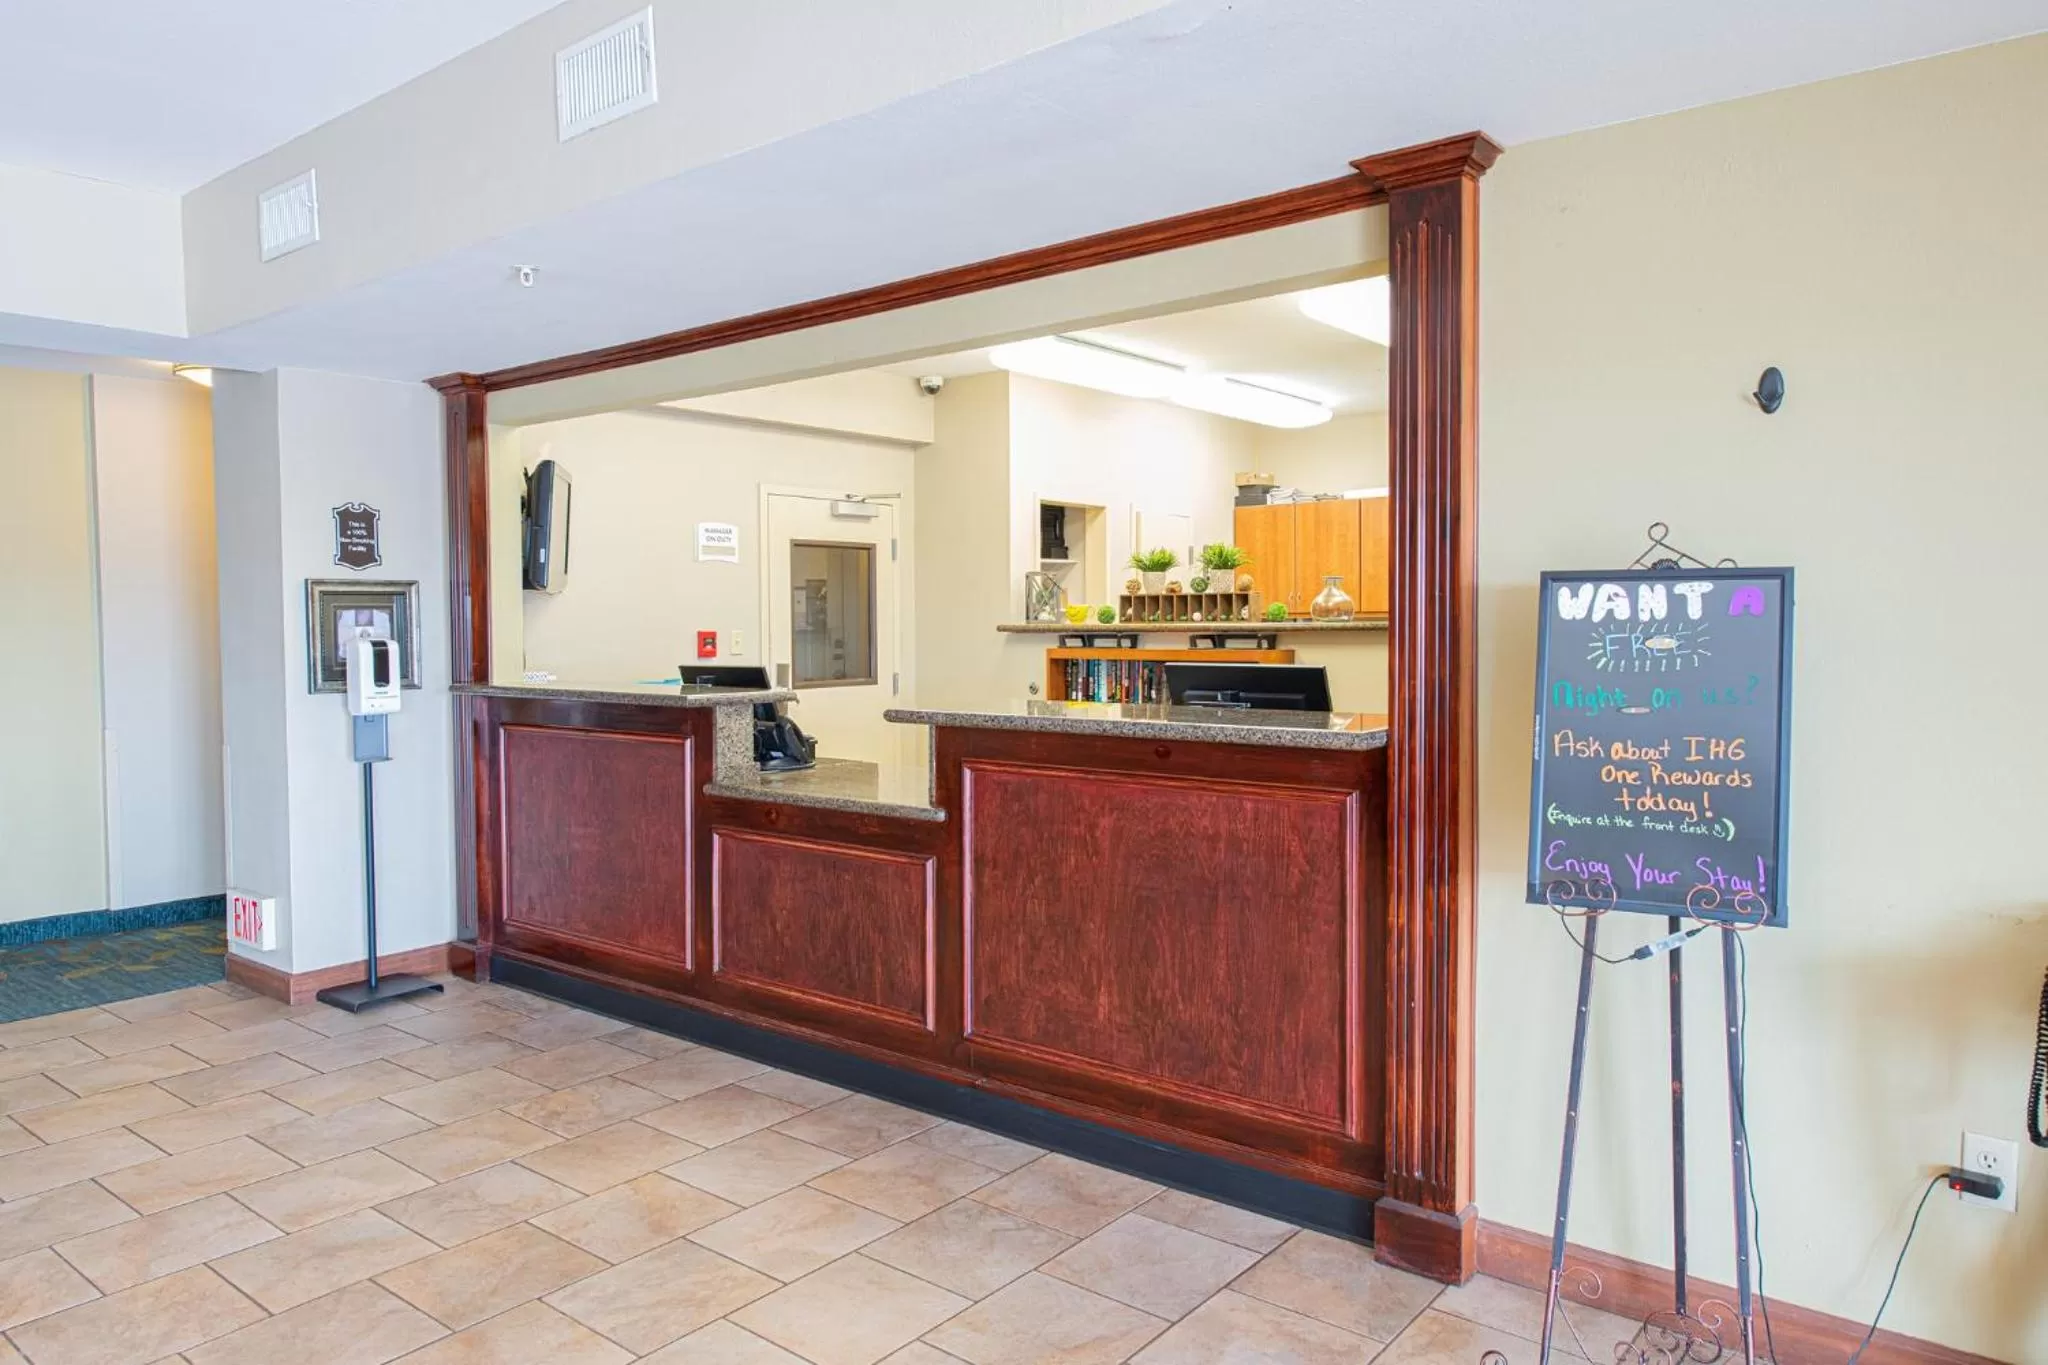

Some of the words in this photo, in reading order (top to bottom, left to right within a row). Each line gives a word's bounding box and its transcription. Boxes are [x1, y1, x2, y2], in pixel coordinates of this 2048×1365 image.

[1558, 582, 1714, 623] WANT
[1728, 585, 1765, 617] A
[1552, 679, 1627, 716] Night
[1553, 729, 1605, 758] Ask
[1610, 738, 1671, 761] about
[1683, 736, 1747, 761] IHG
[1600, 765, 1641, 785] One
[1648, 761, 1753, 787] Rewards
[1597, 813, 1611, 826] at
[1614, 815, 1635, 828] the
[1641, 816, 1674, 831] front
[1545, 839, 1612, 884] Enjoy
[1625, 852, 1682, 891] Your
[1695, 854, 1767, 900] Stay!
[233, 896, 257, 944] EXIT
